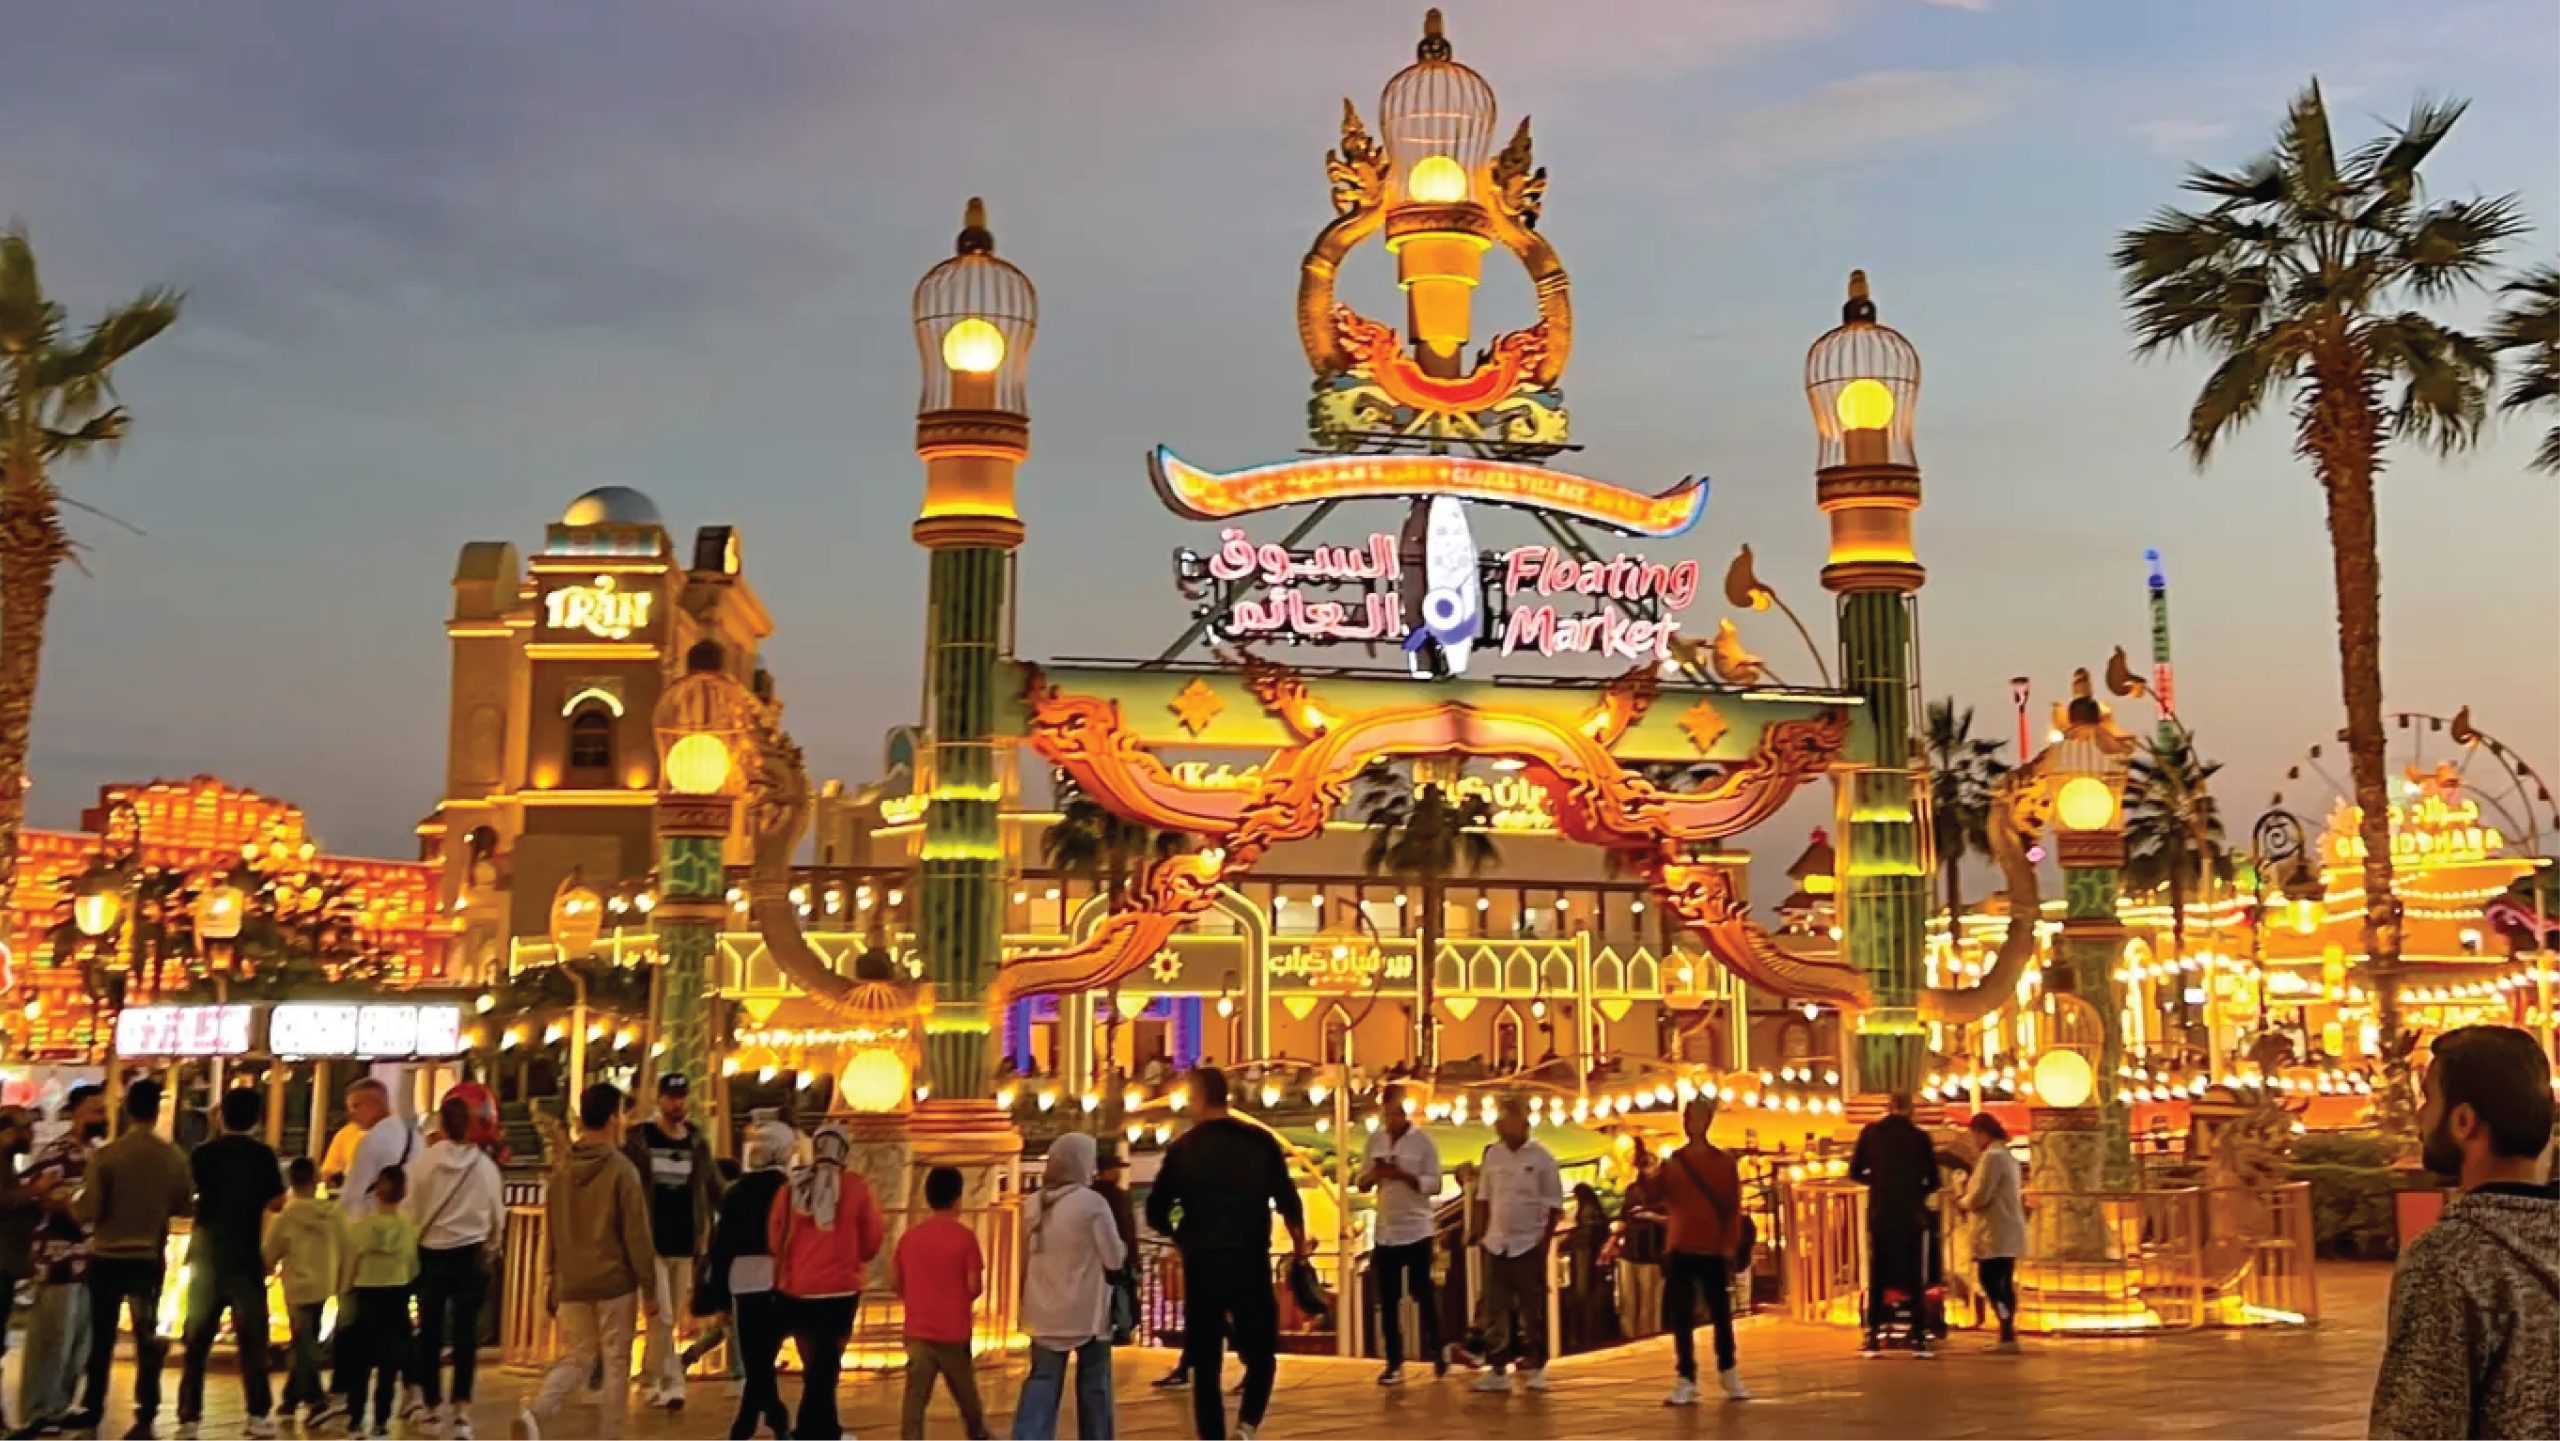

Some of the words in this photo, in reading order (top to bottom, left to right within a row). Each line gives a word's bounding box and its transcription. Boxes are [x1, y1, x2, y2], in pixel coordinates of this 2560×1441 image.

[1209, 528, 1400, 583] السوق
[1502, 545, 1699, 610] Floating
[1225, 587, 1400, 638] العائم
[1501, 605, 1682, 659] Market
